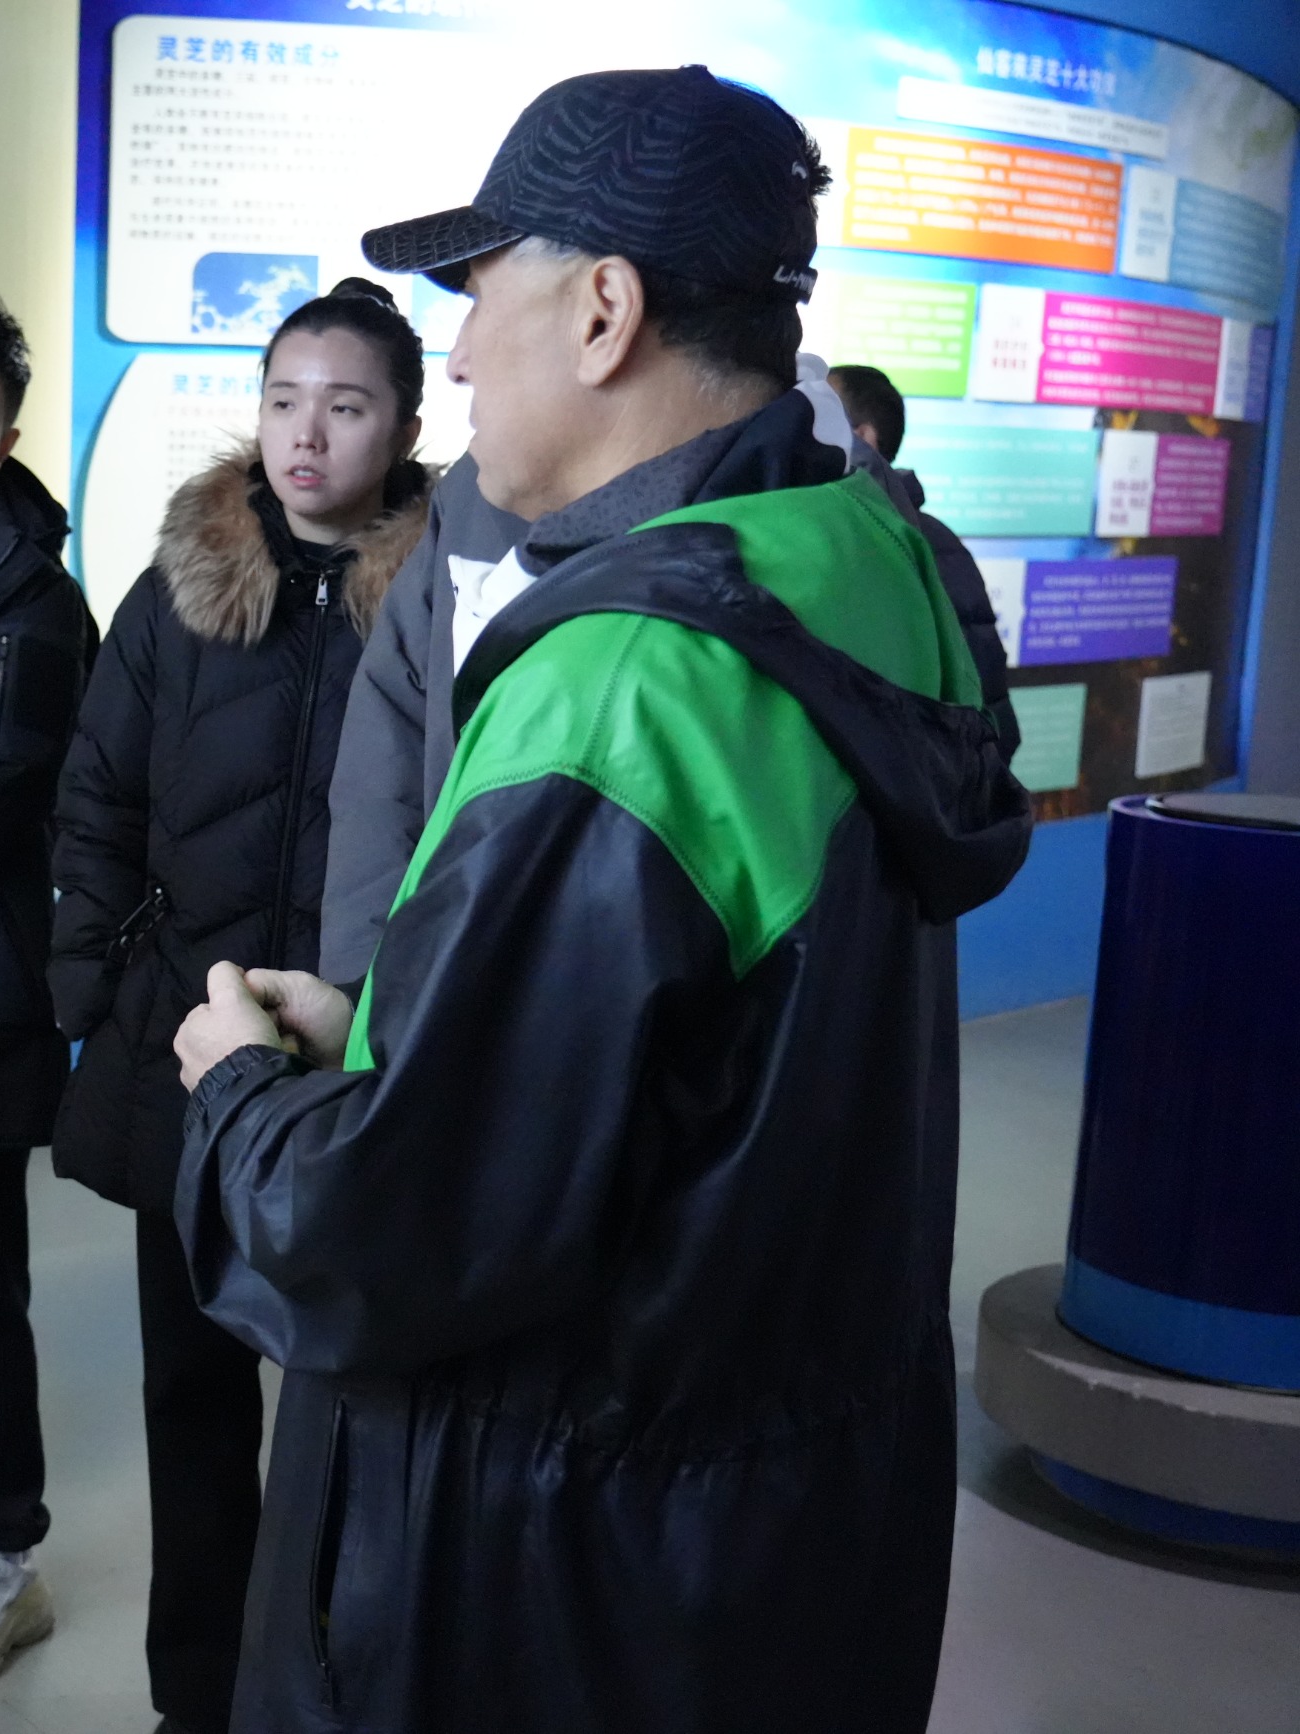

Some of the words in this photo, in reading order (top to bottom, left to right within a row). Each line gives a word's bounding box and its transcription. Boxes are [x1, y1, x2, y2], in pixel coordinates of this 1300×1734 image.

[158, 36, 340, 66] 灵芝的有效成分
